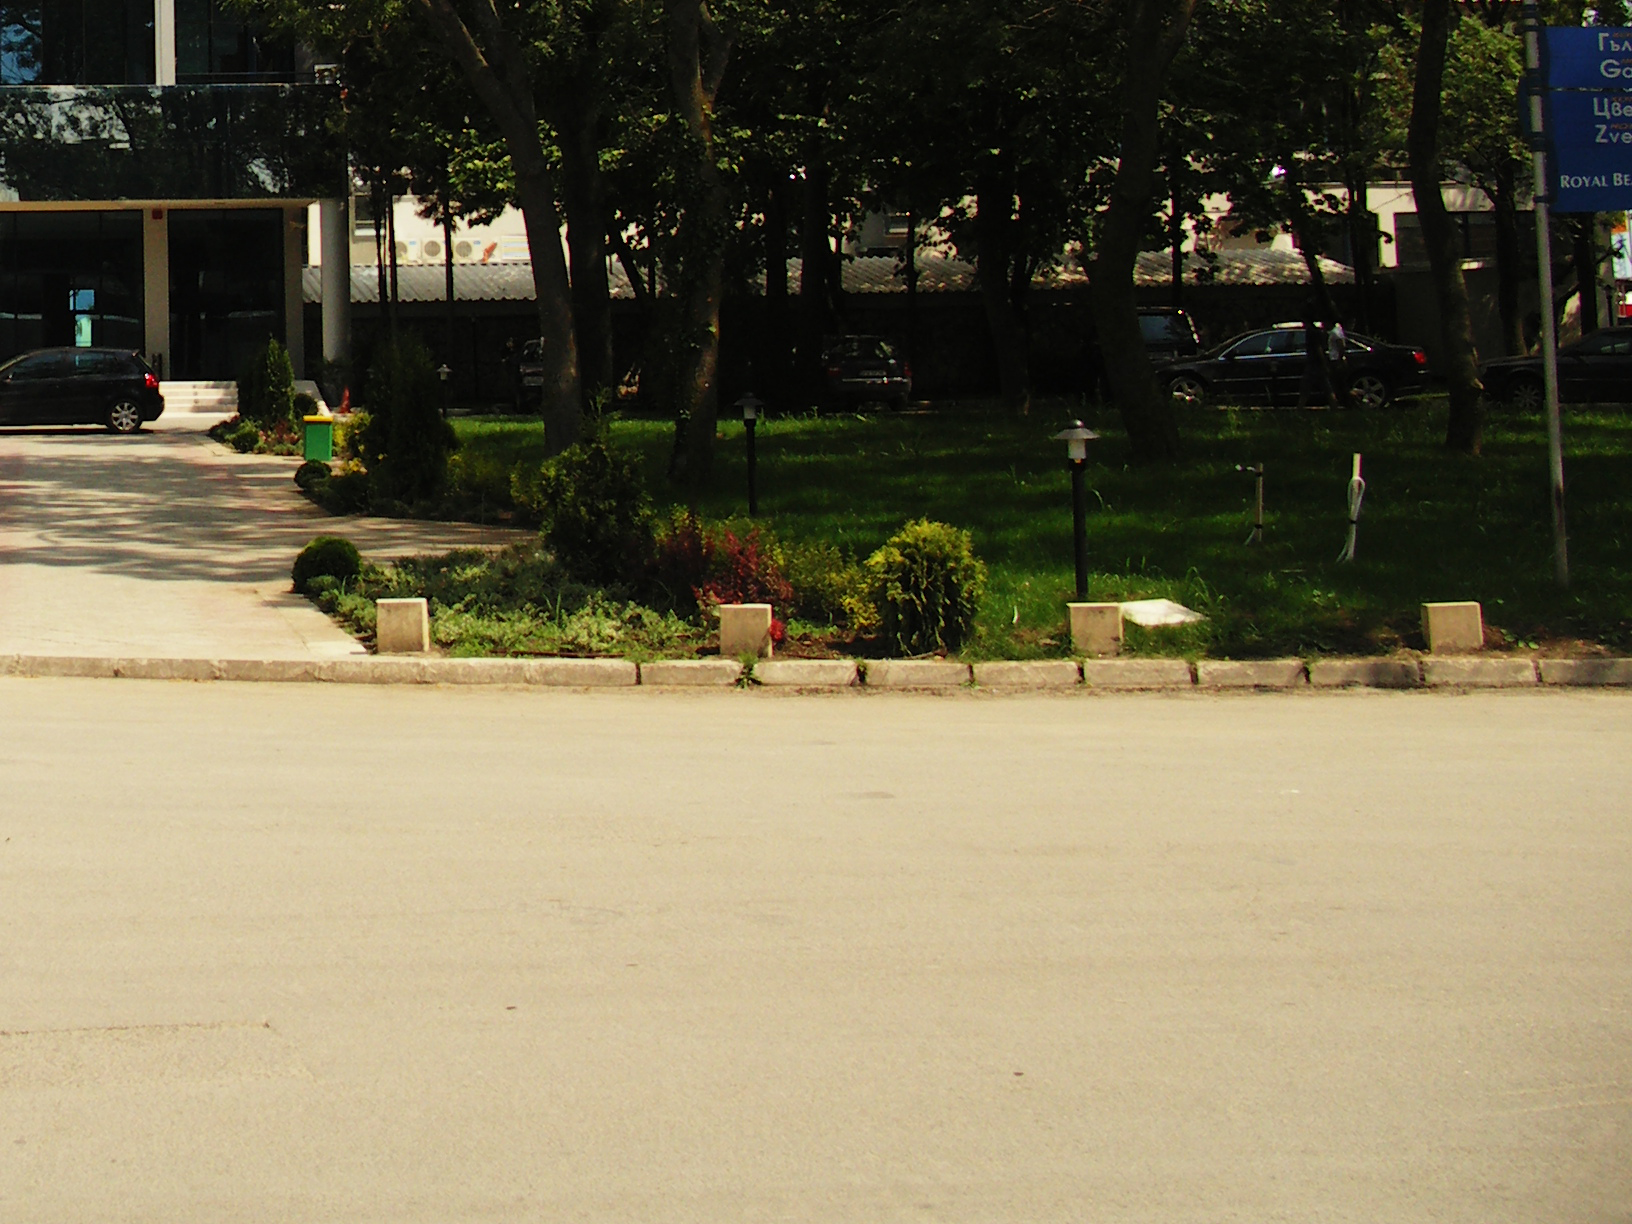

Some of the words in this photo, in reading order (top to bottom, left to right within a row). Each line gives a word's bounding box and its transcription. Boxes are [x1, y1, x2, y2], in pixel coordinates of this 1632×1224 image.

[1594, 124, 1632, 144] Zve
[1560, 174, 1608, 188] ROYAL
[1612, 172, 1632, 187] BE
